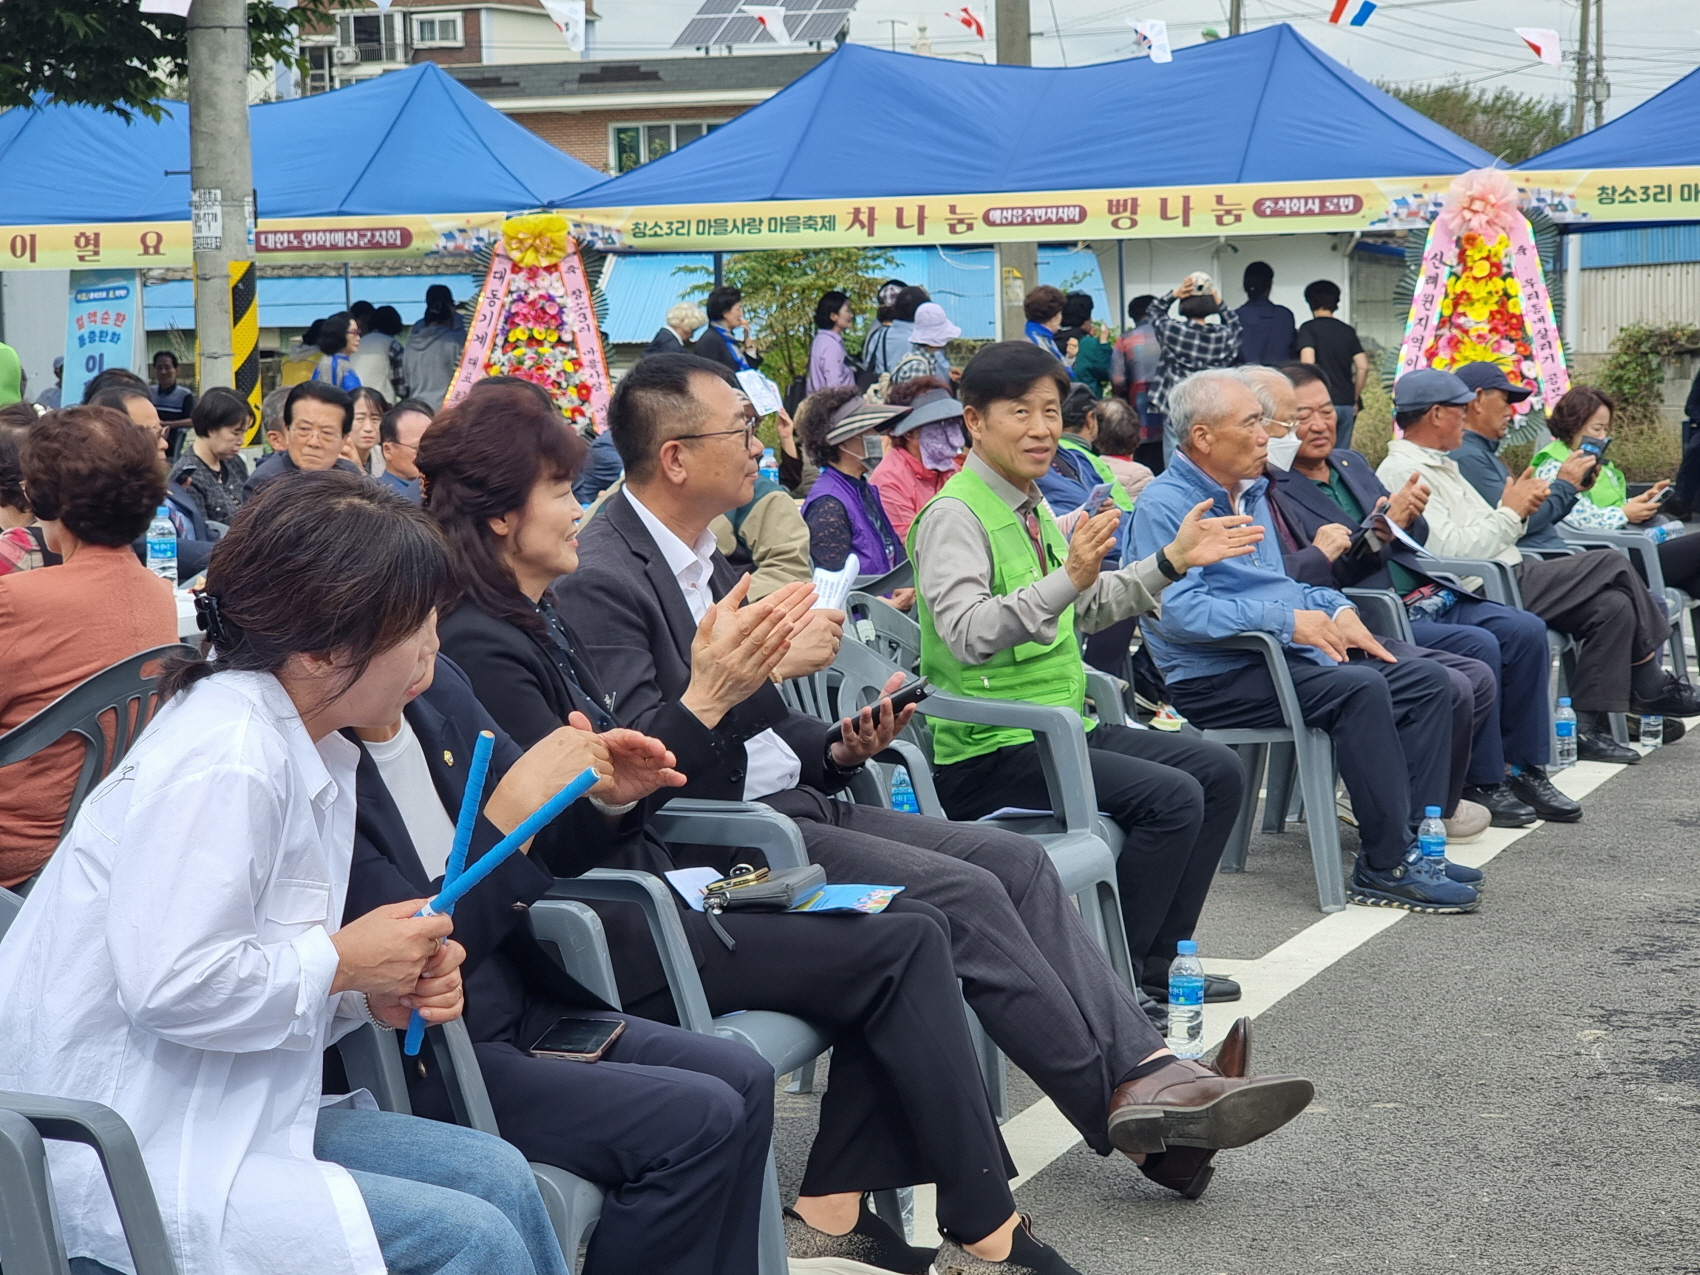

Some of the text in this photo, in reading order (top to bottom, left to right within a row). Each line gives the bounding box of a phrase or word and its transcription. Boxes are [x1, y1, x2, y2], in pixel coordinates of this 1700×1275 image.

[1597, 184, 1672, 205] 창소3리
[631, 220, 691, 238] 창소3리
[696, 216, 764, 236] 마을사랑
[767, 214, 836, 234] 마을축제
[1260, 198, 1320, 216] 주식회사
[259, 229, 402, 249] 대한노인회예산군지회
